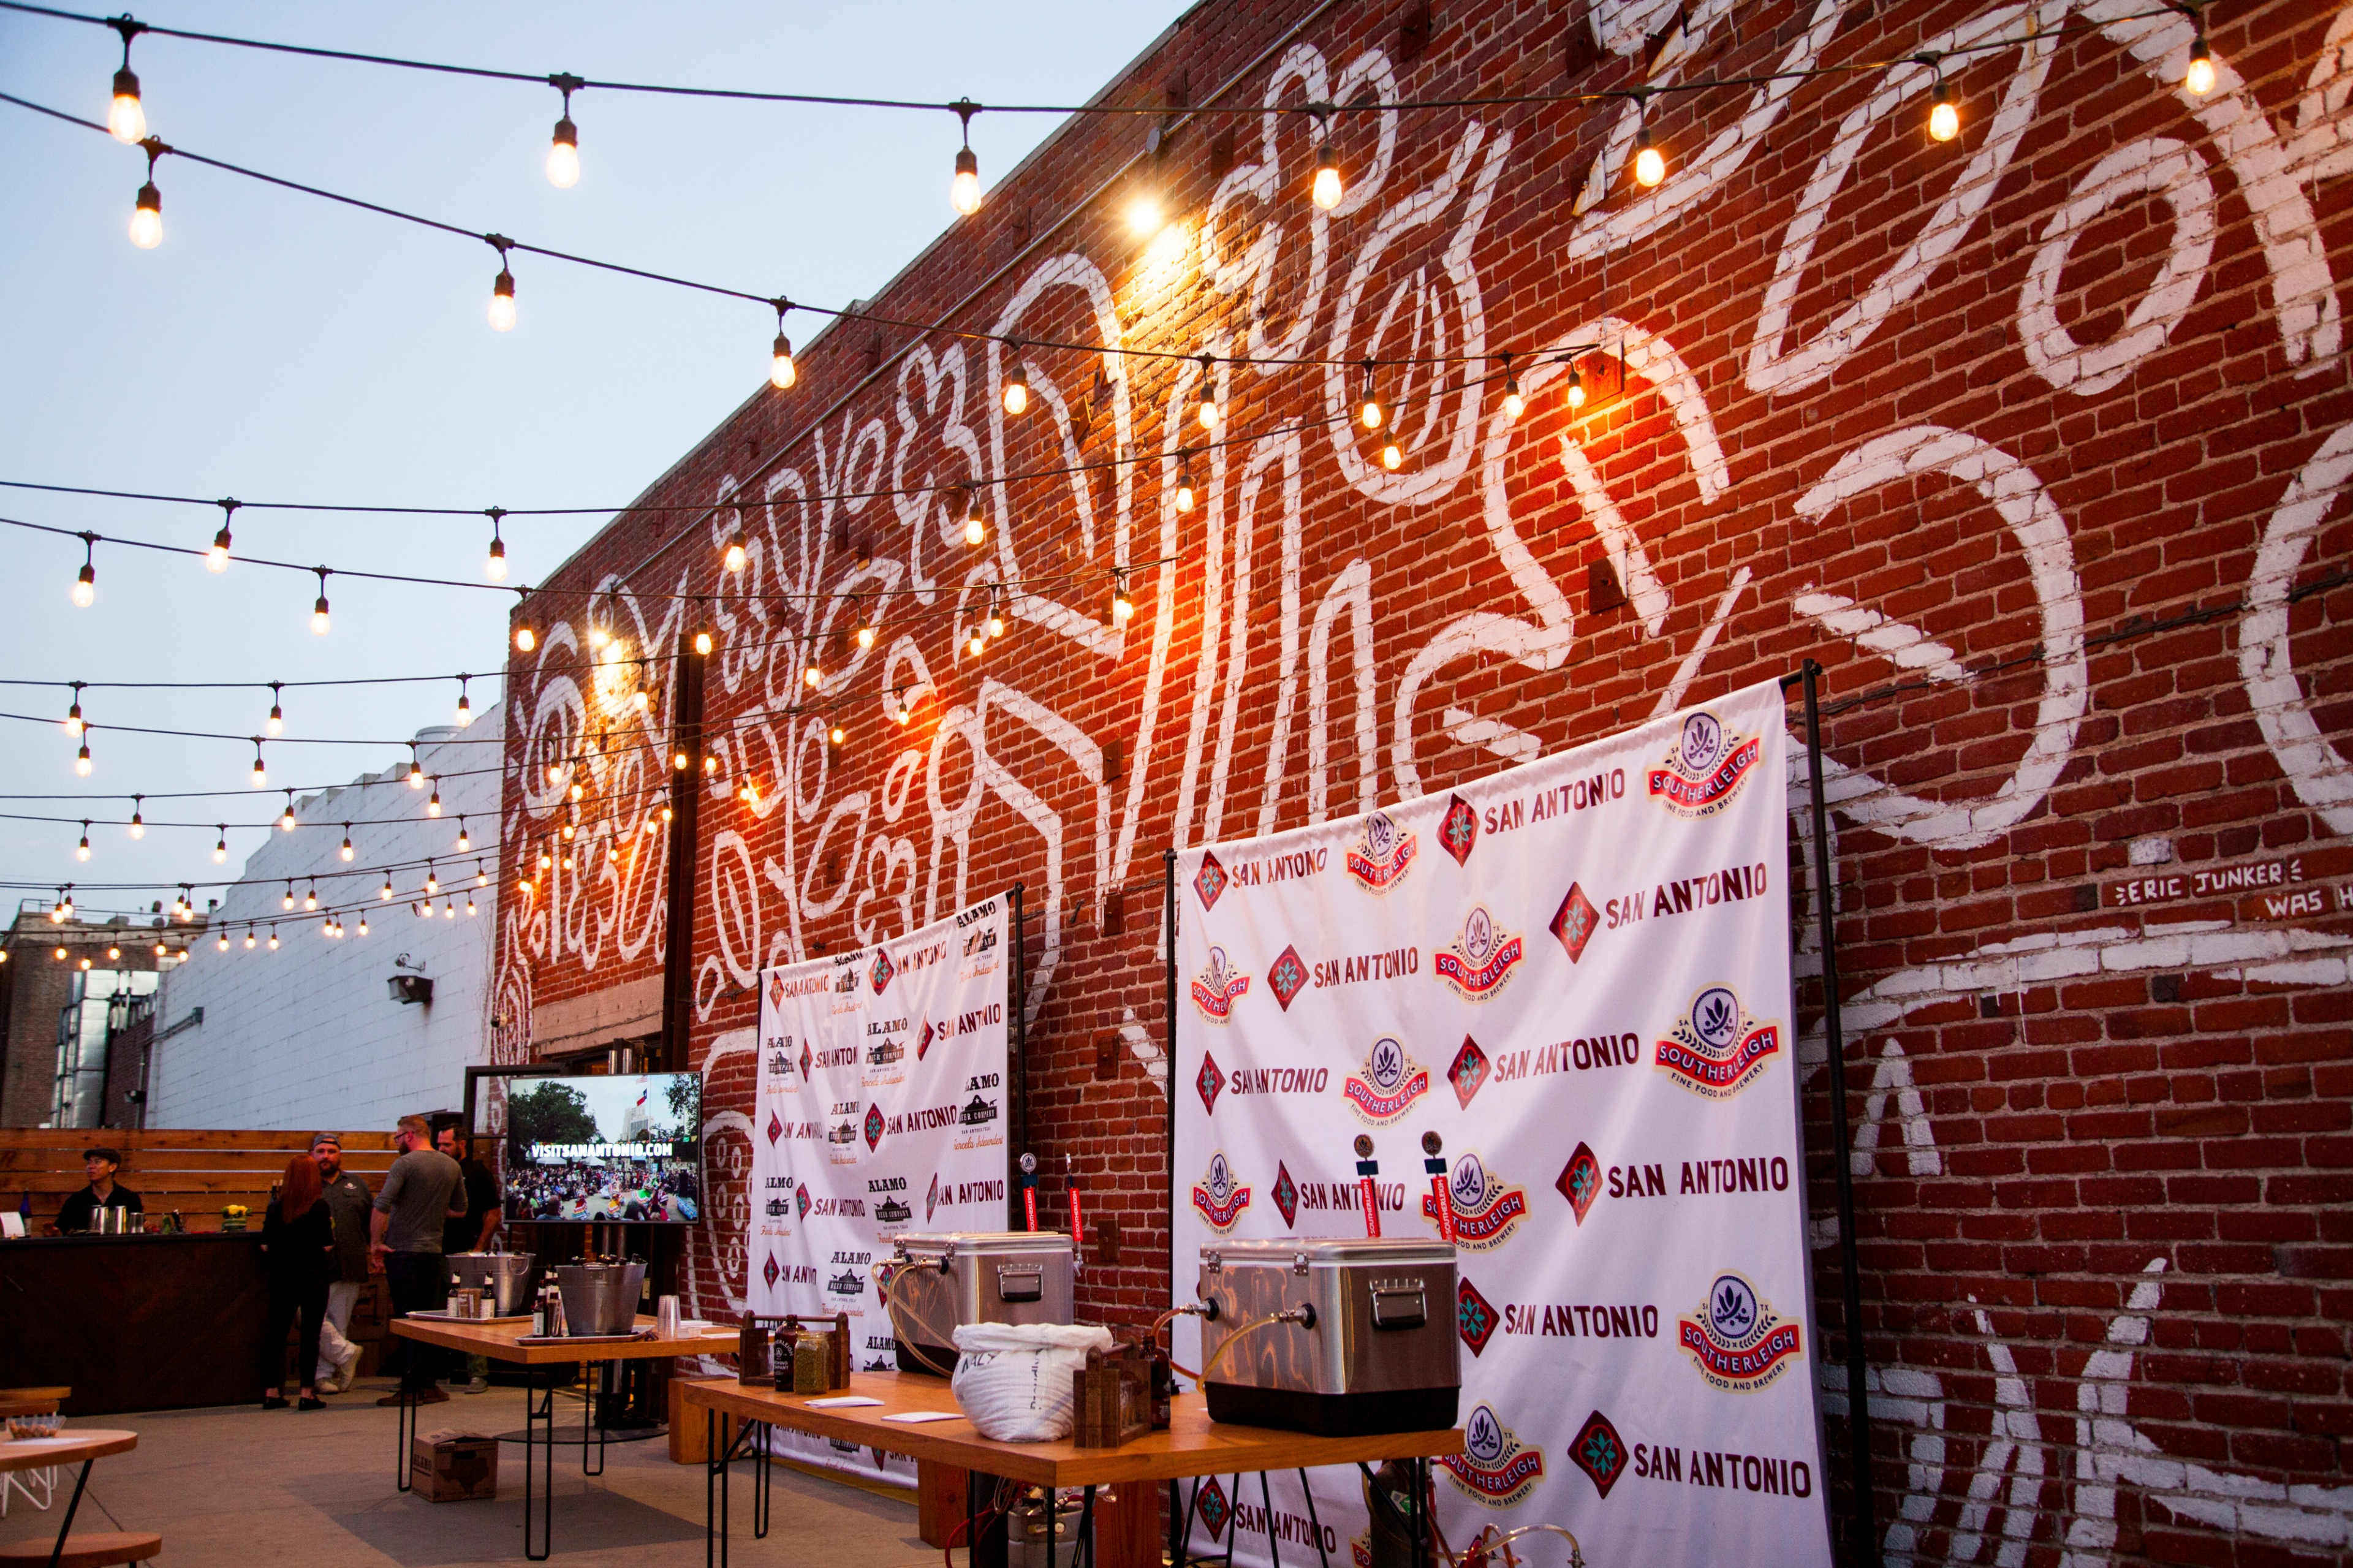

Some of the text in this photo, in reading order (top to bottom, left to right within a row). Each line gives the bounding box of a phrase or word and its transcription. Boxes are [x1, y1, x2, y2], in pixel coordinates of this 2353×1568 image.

[1654, 744, 1756, 801] SOUTHERLEIGH
[1485, 767, 1626, 835] SAN ANTONIO
[1662, 800, 1677, 813] FINE
[1696, 806, 1715, 817] AND
[1717, 776, 1748, 809] BREWERY
[1232, 847, 1328, 888] SAN ANTONO
[2128, 861, 2282, 903] ERIC JUNKER
[1605, 862, 1767, 930] SAN ANTONIO
[2264, 889, 2324, 917] WAS
[956, 901, 996, 928] ALAMO
[896, 955, 909, 977] AN
[1314, 946, 1419, 988] SAN ANTONIO
[1440, 942, 1519, 987] SOUTHERLEIGH
[1448, 980, 1461, 994] FINE
[1477, 993, 1488, 1001] AND
[1490, 969, 1514, 997] BREWERY
[867, 1017, 907, 1036] ALAMO
[938, 1018, 956, 1040] SAN
[1495, 1032, 1640, 1083] SAN ANTONIO
[1659, 1032, 1774, 1081] SOUTHERLEIGH
[1230, 1067, 1329, 1096] SAN ANTONIO
[1347, 1076, 1426, 1114] SOUTHERLEIGH
[1671, 1062, 1764, 1098] FINE FOOD AND BREWERY
[887, 1105, 957, 1135] SAN ANTONIO
[974, 1110, 995, 1120] COMPANY
[1351, 1104, 1362, 1117] FINE
[1361, 1115, 1375, 1126] FOOD
[1390, 1102, 1417, 1124] BREWERY
[531, 1142, 673, 1158] VISITSANANTONIO.COM
[868, 1176, 907, 1193] ALAMO
[938, 1179, 1004, 1206] AN ANTONIO
[1608, 1155, 1789, 1199] SAN ANTONIO
[814, 1199, 866, 1217] SAN ANTONIO
[889, 1209, 910, 1218] COMPANY
[1195, 1191, 1247, 1222] SOUTHERLEIGH
[1300, 1183, 1406, 1211] SAN ANTNIO
[1363, 1181, 1376, 1235] SOUTHERLEIGH
[1437, 1179, 1452, 1234] SOUTHERLEIGH
[1426, 1195, 1521, 1235] STHERLEIGH
[1457, 1239, 1471, 1249] OOD
[1489, 1221, 1515, 1248] BREWERY
[830, 1251, 871, 1265] ALAMO
[1504, 1303, 1658, 1338] SAN ANTONIO
[1684, 1326, 1795, 1372] SOUTHERLEIGH
[1693, 1355, 1786, 1390] FINE FOOD AND BREWERY
[1634, 1442, 1811, 1499] SAN ANTONIO
[1450, 1474, 1465, 1491] FINE
[1468, 1488, 1487, 1503] FOOD
[1504, 1482, 1533, 1506] BREWERY
[1235, 1502, 1267, 1535] SAN
